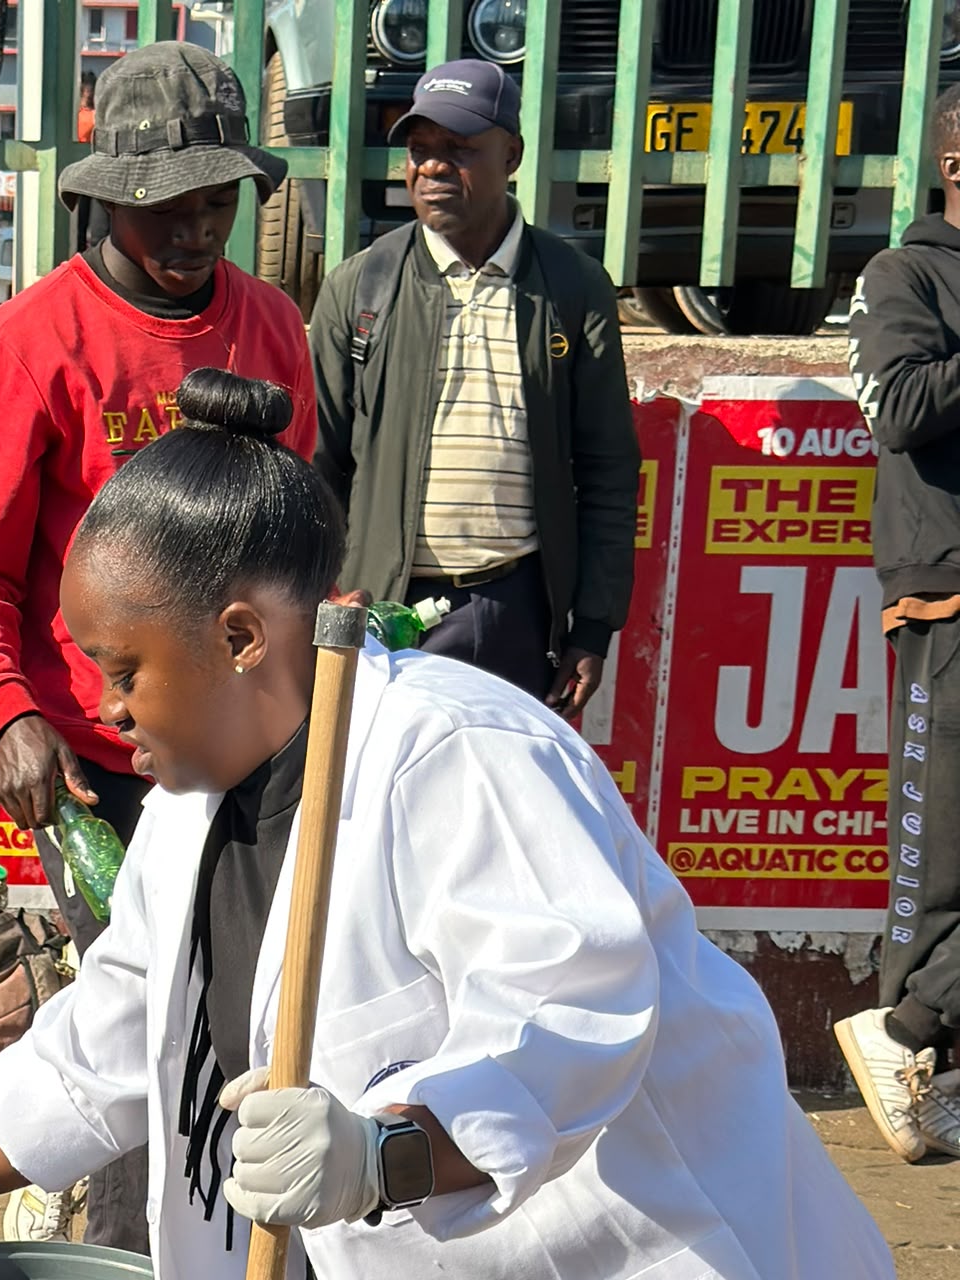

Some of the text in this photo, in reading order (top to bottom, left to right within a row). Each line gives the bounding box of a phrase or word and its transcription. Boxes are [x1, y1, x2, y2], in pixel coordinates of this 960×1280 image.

[757, 427, 796, 457] 10
[720, 479, 858, 513] THE
[711, 519, 872, 544] EXPER
[714, 566, 889, 754] JA
[679, 808, 761, 834] LIVE
[766, 809, 805, 834] IN
[670, 847, 889, 874] @AQUATIC CO
[891, 780, 924, 945] JUNIOR
